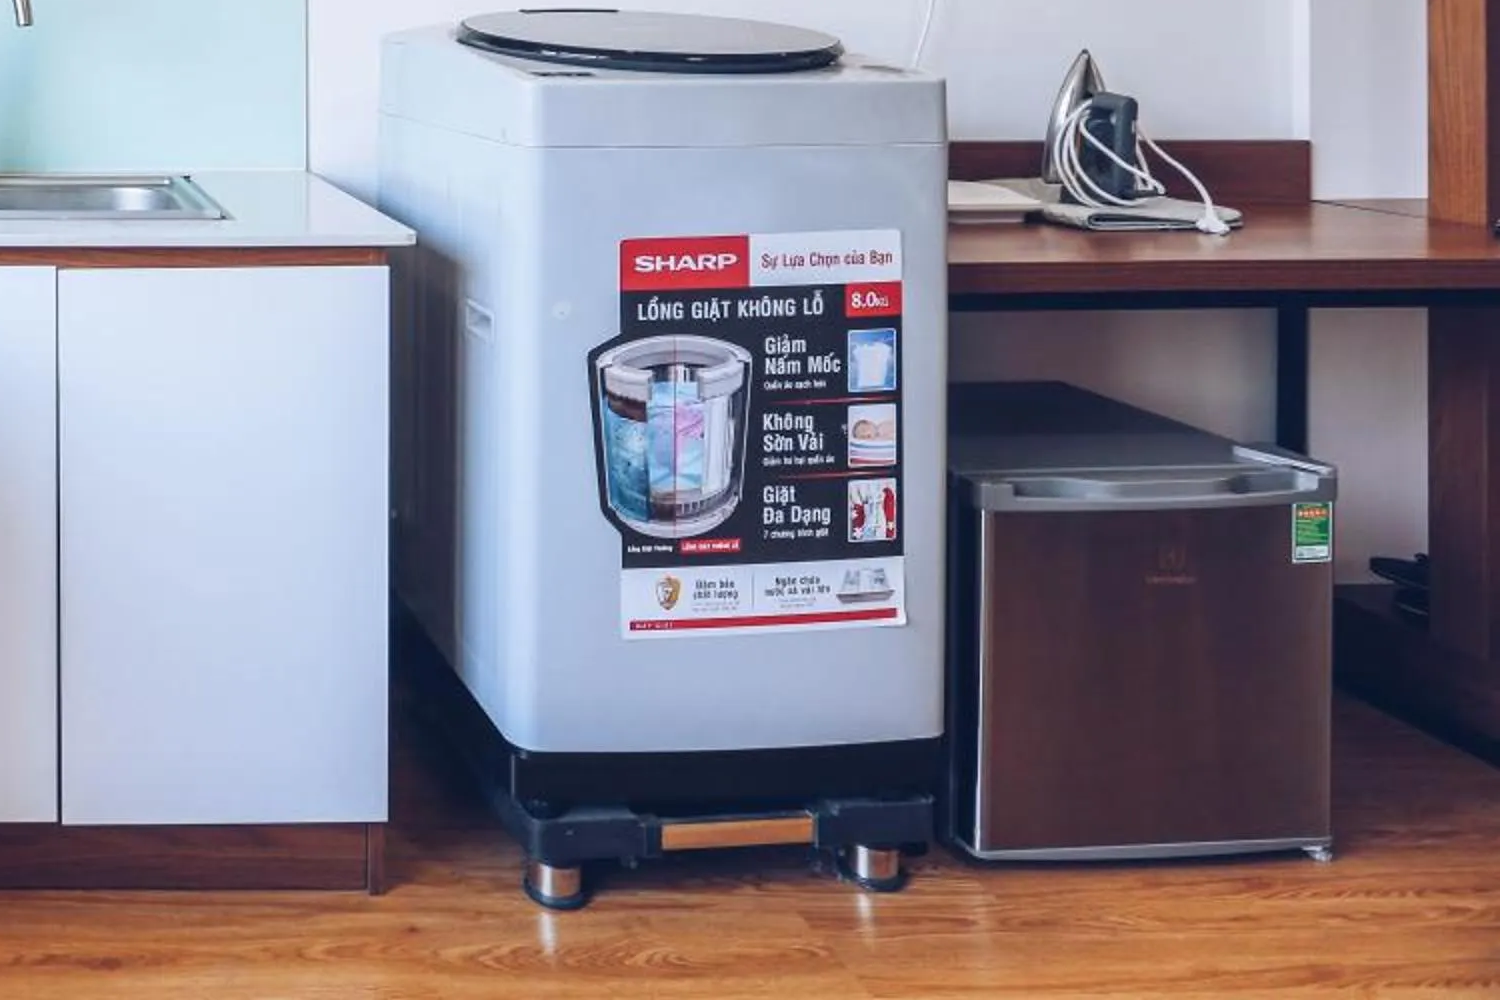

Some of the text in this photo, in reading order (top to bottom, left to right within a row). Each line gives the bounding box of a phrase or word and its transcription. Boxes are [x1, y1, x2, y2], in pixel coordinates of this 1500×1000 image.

[634, 253, 738, 273] SHARP
[809, 251, 840, 268] Chọn
[844, 249, 865, 265] của
[870, 249, 893, 266] Bạn
[691, 297, 731, 322] GIẶT
[737, 295, 797, 318] KHÔNG
[765, 333, 807, 354] Giảm
[765, 352, 841, 375] Nấm Mốc
[763, 412, 814, 433] Không
[763, 432, 824, 452] Sờn Vải
[763, 485, 796, 506] Giặt
[763, 505, 831, 526] Đa Dạng
